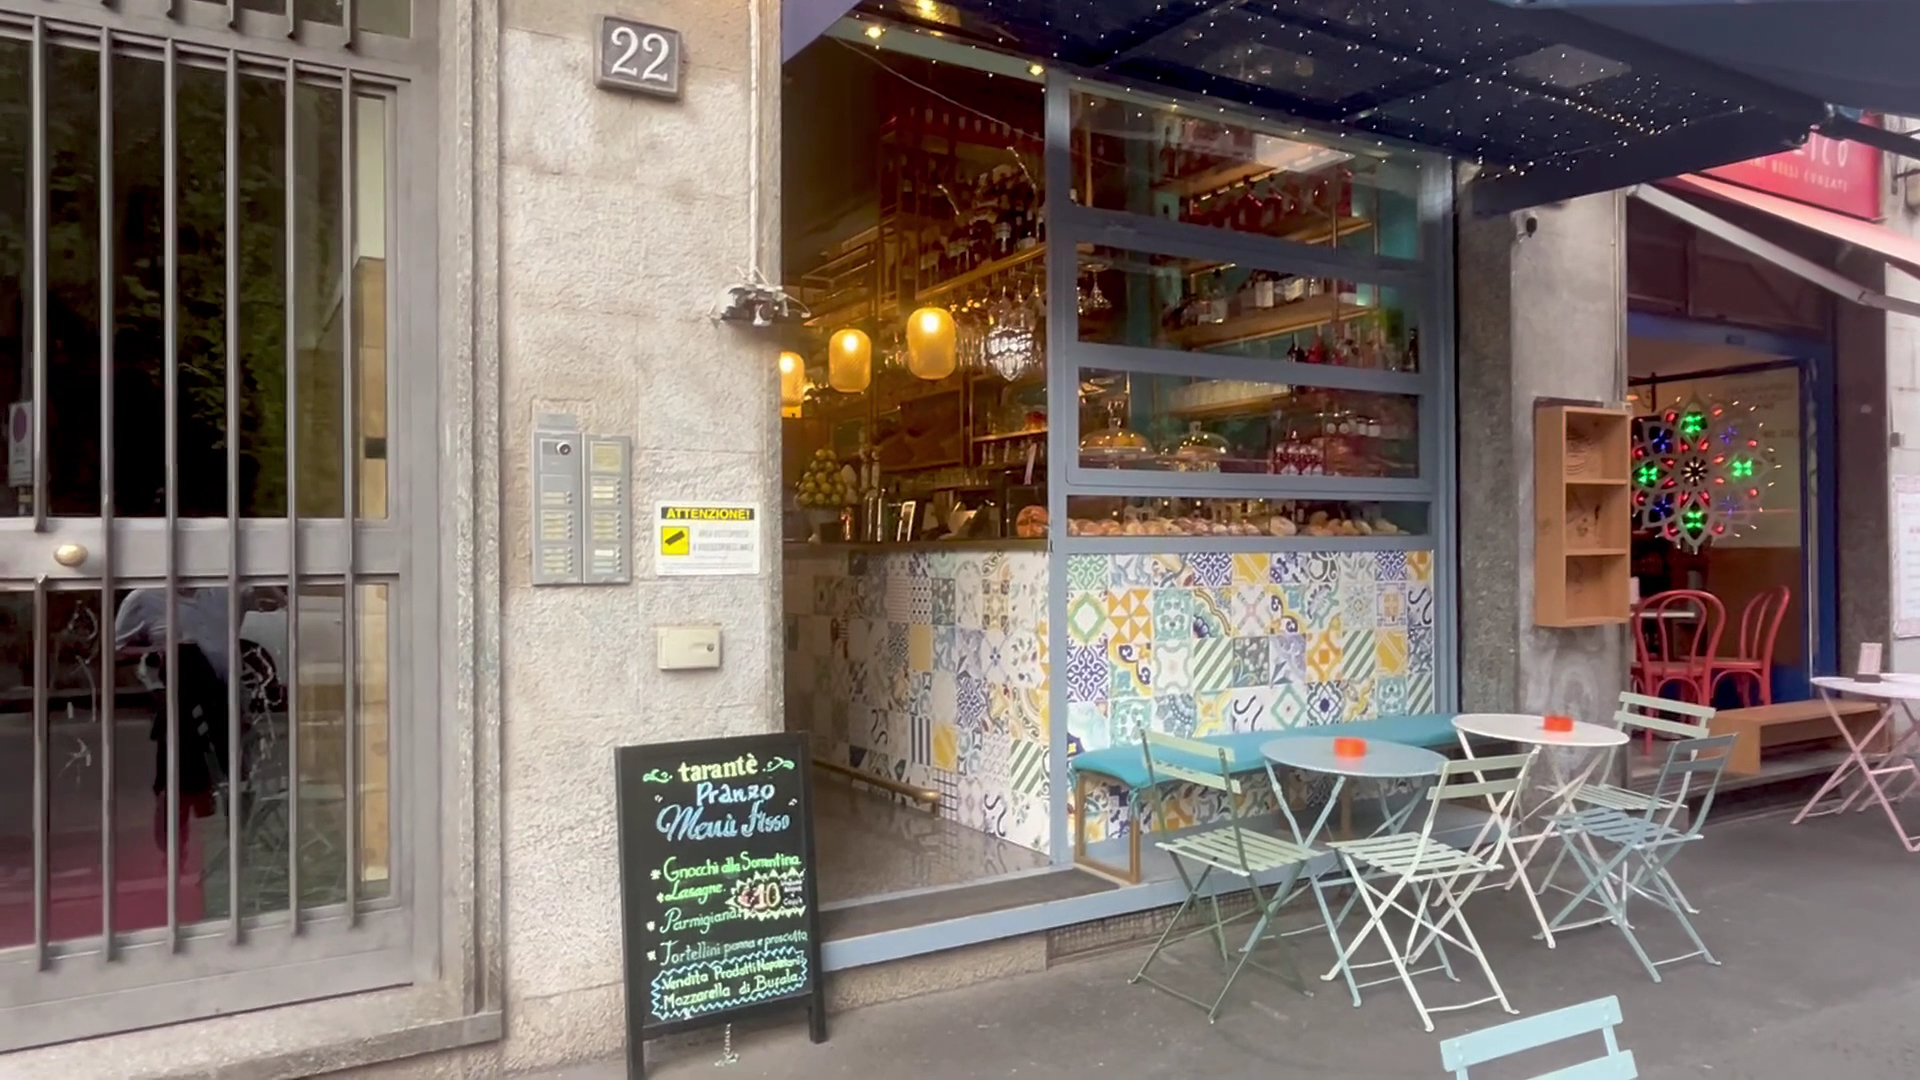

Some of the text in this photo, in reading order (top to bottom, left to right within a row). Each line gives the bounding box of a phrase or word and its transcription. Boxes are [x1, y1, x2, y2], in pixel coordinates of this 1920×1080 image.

[611, 26, 669, 82] 22
[666, 507, 751, 520] ATTENZIONE!
[678, 753, 758, 783] tarantè
[696, 781, 775, 807] Pranzo
[656, 804, 738, 842] Menù
[721, 857, 741, 874] alla
[660, 939, 721, 966] Tortellini
[723, 940, 756, 961] panna
[738, 982, 751, 995] di
